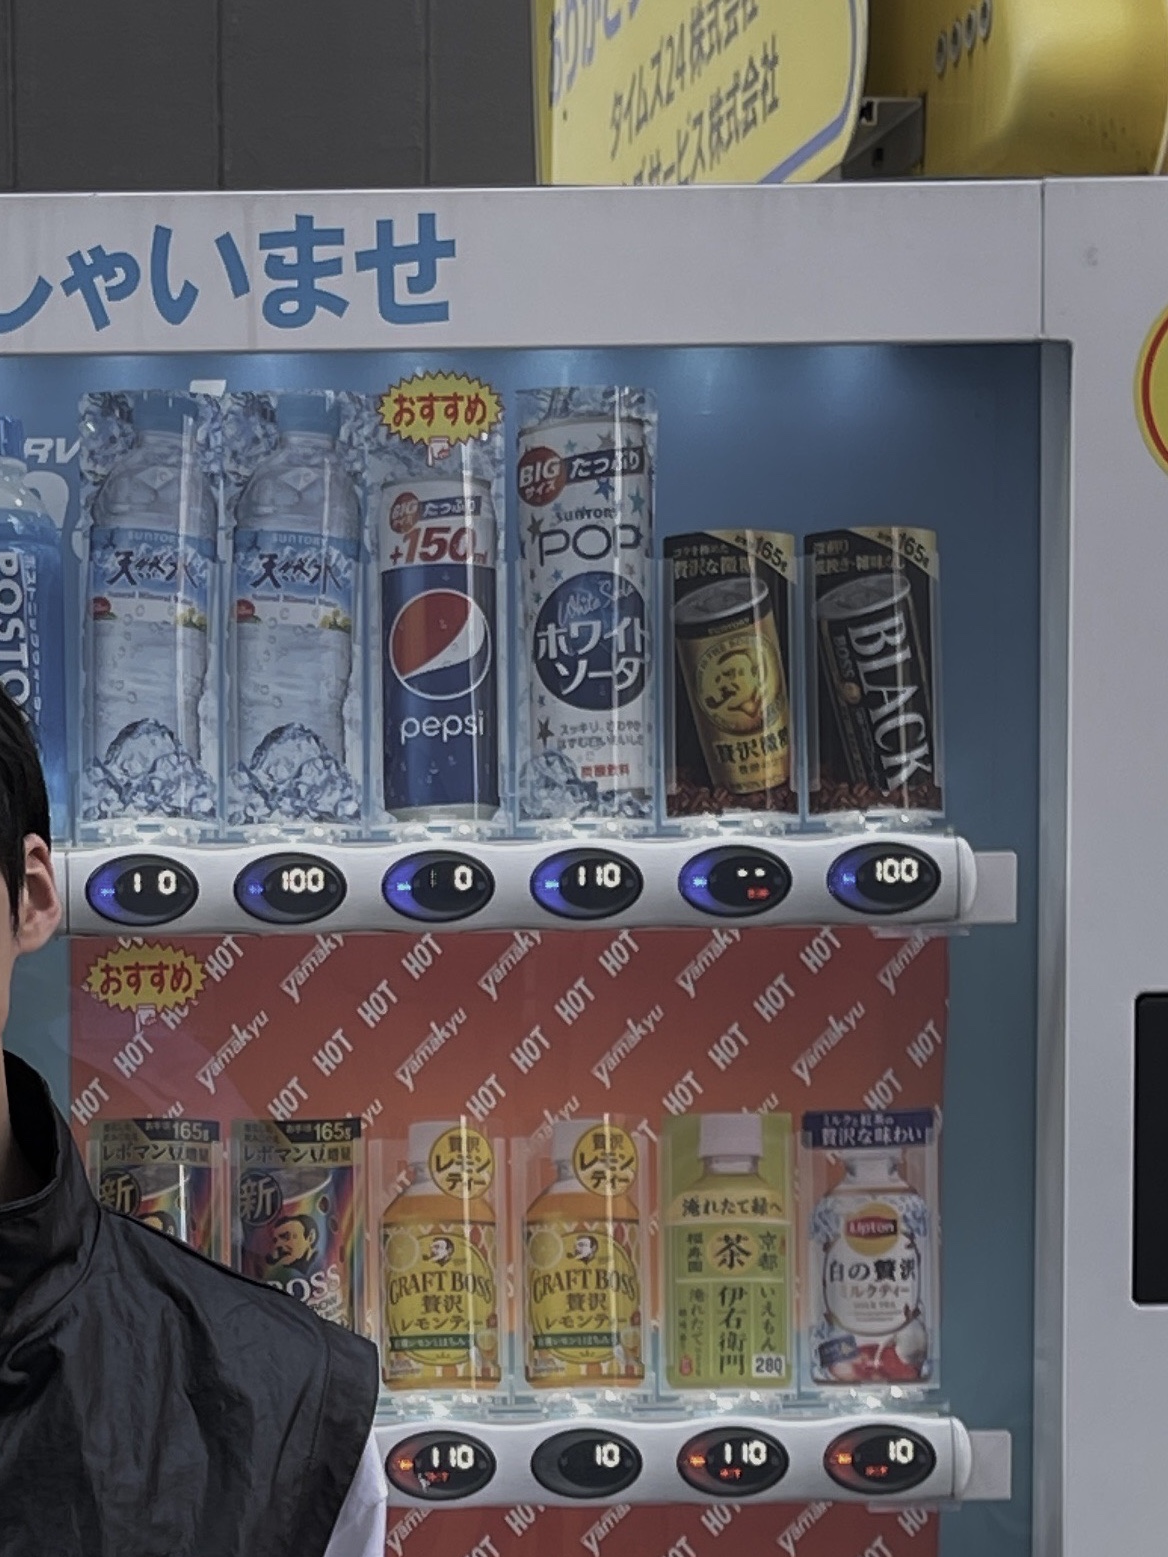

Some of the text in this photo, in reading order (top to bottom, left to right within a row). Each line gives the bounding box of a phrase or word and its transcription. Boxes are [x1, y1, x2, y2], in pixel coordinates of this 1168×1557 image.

[392, 394, 487, 428] おすすめ
[519, 458, 561, 490] BIG
[569, 451, 640, 477] たっぷり
[106, 551, 198, 588] 天然水
[250, 553, 342, 594] 天然水
[537, 618, 647, 657] ホワイト
[847, 612, 932, 791] BLACK
[400, 709, 485, 745] pepsi
[281, 866, 325, 894] 100
[875, 857, 920, 883] 100
[204, 935, 245, 982] HOT
[401, 933, 444, 979] HOT
[599, 928, 641, 978] HOT
[799, 926, 842, 974] HOT
[99, 961, 193, 996] おすすめ
[753, 973, 796, 1023] HOT
[357, 980, 399, 1029] HOT
[554, 976, 596, 1026] HOT
[113, 1034, 155, 1079] HOT
[195, 1011, 270, 1094] yamakyu
[312, 1028, 355, 1078] HOT
[394, 1007, 468, 1093] yamakyu
[509, 1025, 551, 1074] HOT
[591, 1003, 665, 1089] yamakyu
[707, 1021, 750, 1071] HOT
[791, 1002, 866, 1086] yamakyu
[906, 1019, 943, 1068] HOT
[70, 1078, 111, 1126] HOT
[268, 1076, 309, 1122] HOT
[465, 1073, 507, 1122] HOT
[662, 1070, 704, 1116] HOT
[864, 1067, 903, 1112] HOT
[822, 1126, 922, 1146] 贅沢な味わい
[434, 1153, 491, 1174] レモン
[446, 1174, 486, 1192] ティー
[579, 1152, 635, 1173] レモン
[590, 1171, 630, 1190] ティー
[99, 1171, 135, 1213] 新
[240, 1176, 274, 1219] 新
[849, 1220, 896, 1236] Lipton
[715, 1234, 752, 1270] 茶
[758, 1231, 778, 1272] 京都
[830, 1259, 915, 1283] 白の贅沢
[266, 1264, 340, 1302] OSS
[389, 1270, 492, 1305] CRAFT BOSS
[533, 1268, 636, 1303] CRAFT BOSS
[567, 1292, 607, 1312] 贅沢
[423, 1295, 463, 1314] 贅沢
[719, 1285, 748, 1377] 伊右衛門
